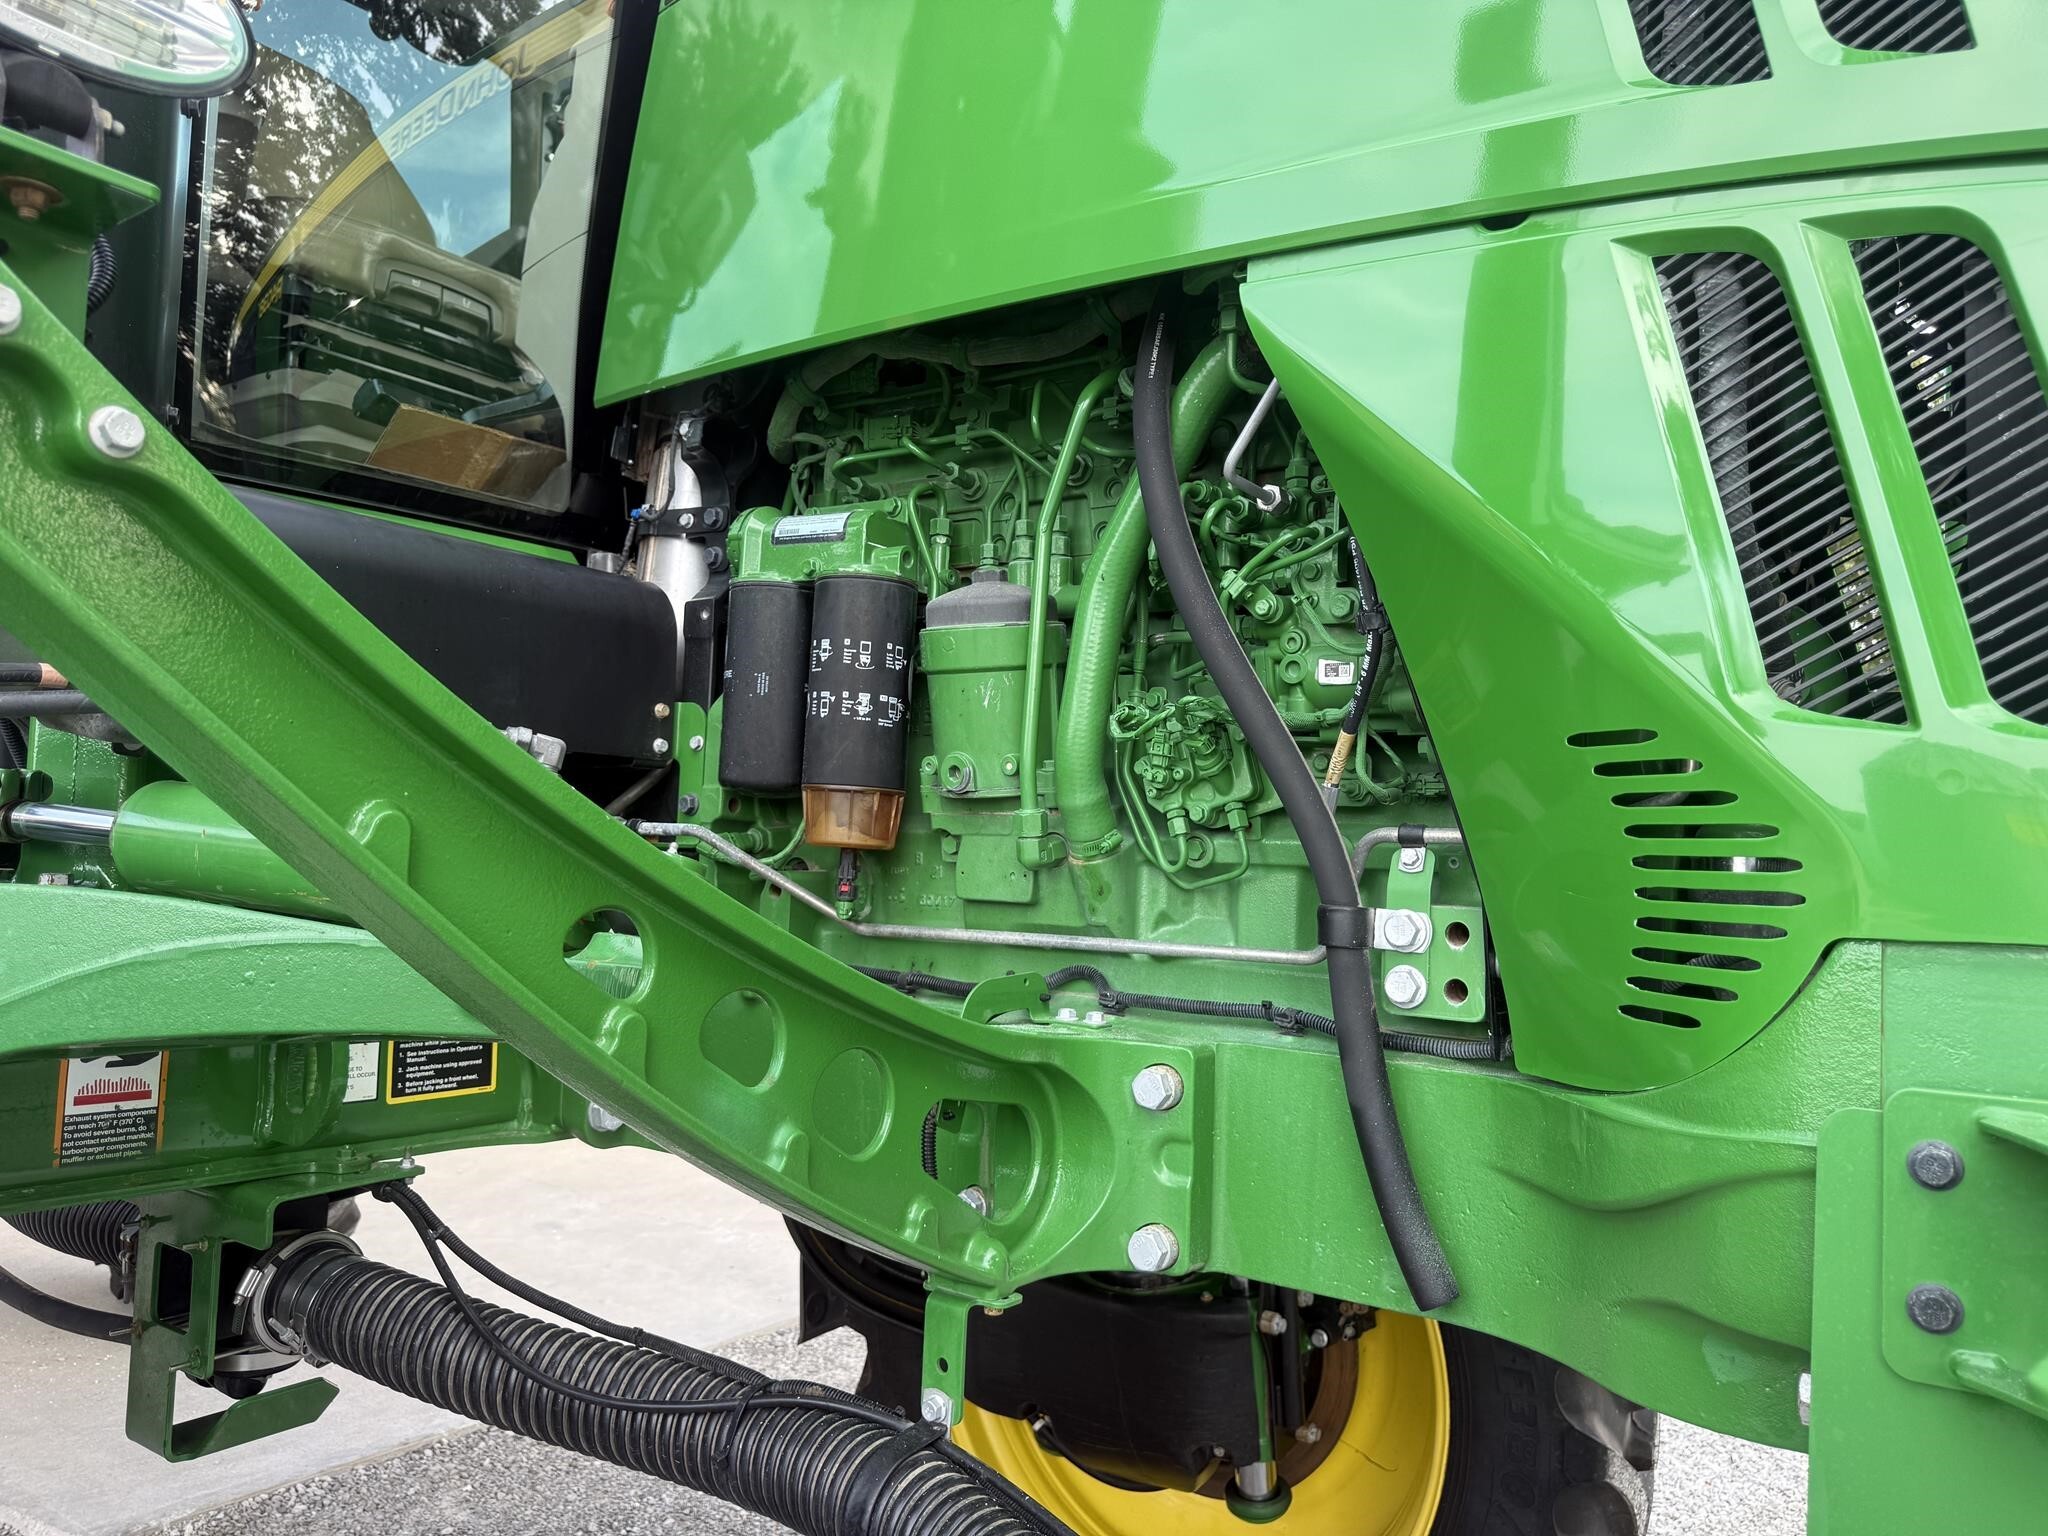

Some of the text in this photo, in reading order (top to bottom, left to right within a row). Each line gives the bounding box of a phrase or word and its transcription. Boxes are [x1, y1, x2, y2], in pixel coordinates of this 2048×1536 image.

[418, 1048, 449, 1056] instructions
[459, 1059, 482, 1067] approved
[424, 1078, 443, 1086] jacking
[93, 1113, 117, 1122] system
[117, 1109, 156, 1118] components
[75, 1138, 99, 1146] contact
[100, 1135, 126, 1143] exhaust
[62, 1146, 105, 1155] turbocharger
[61, 1156, 86, 1164] muffler
[96, 1152, 122, 1160] exhaust
